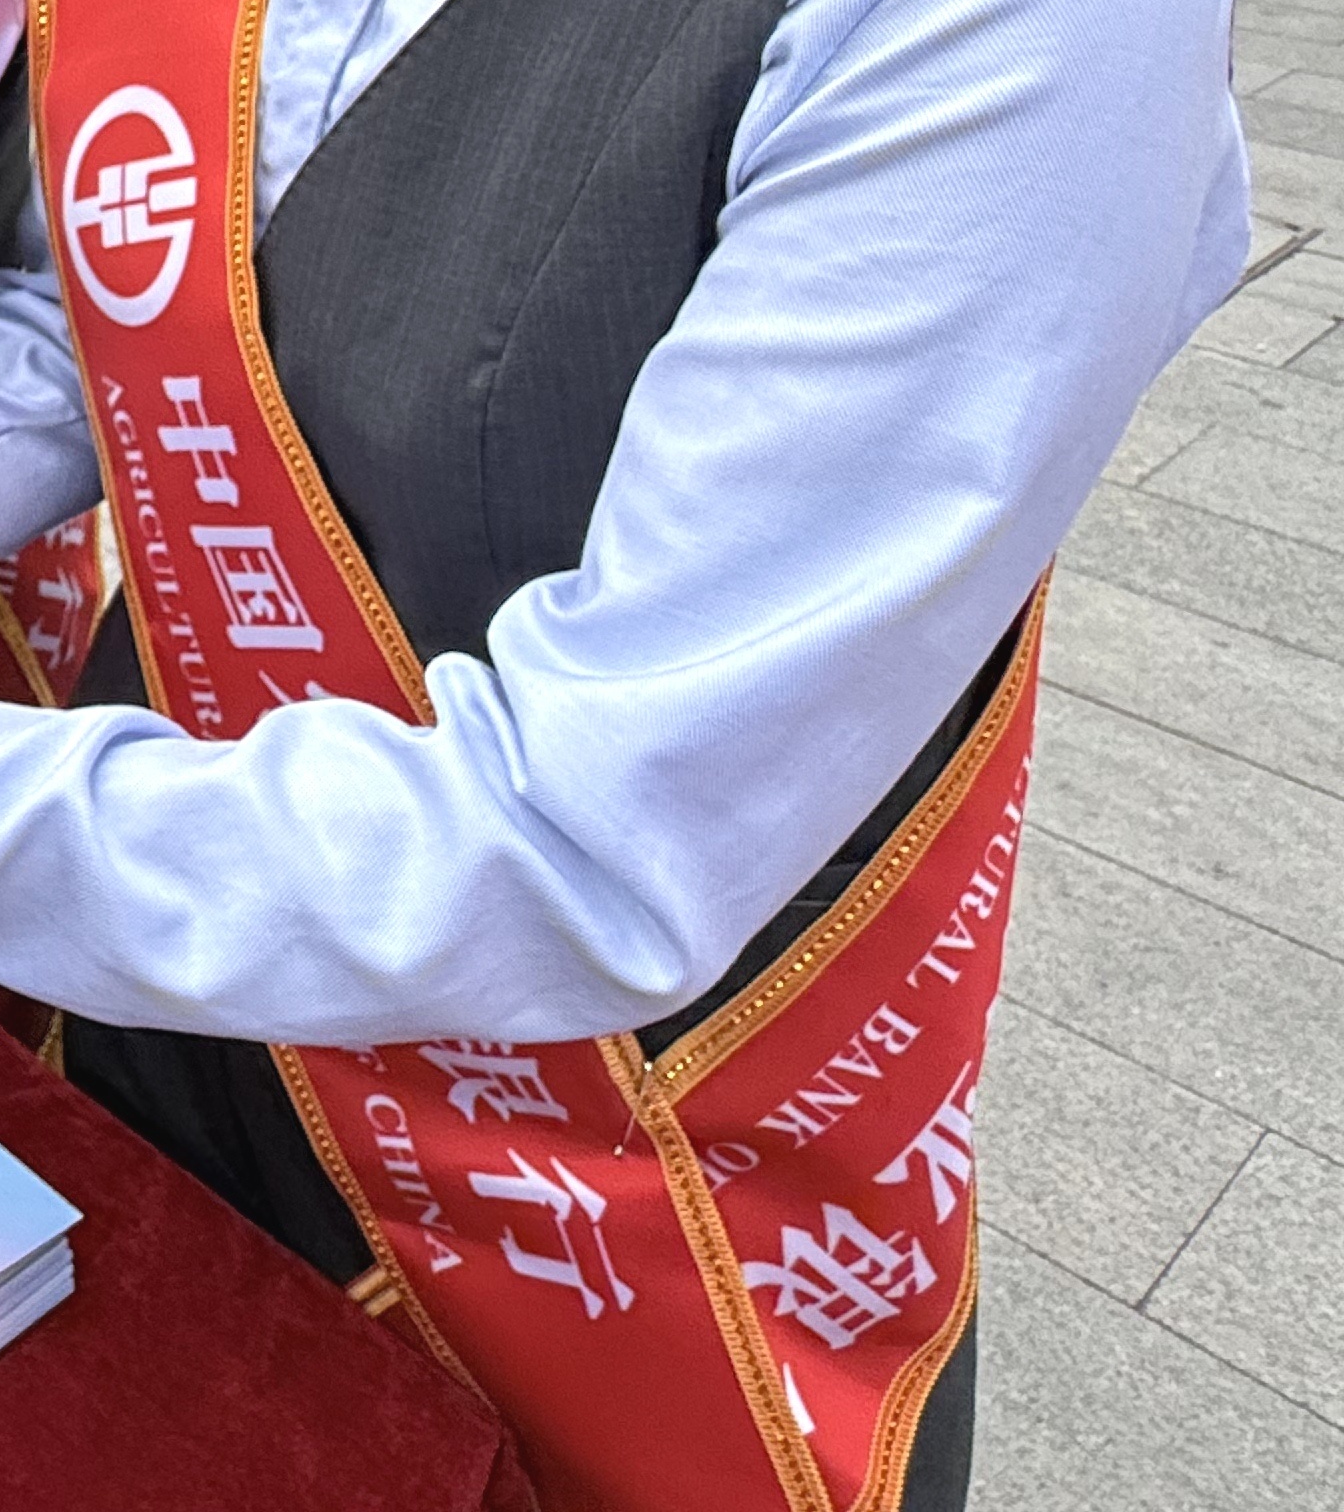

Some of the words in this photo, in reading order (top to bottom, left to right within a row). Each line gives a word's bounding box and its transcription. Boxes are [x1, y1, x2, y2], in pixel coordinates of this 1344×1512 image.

[101, 375, 223, 740] AGRICULTUR
[364, 1093, 464, 1275] CHINA
[416, 1038, 636, 1321] 银行
[755, 1003, 922, 1151] BANK
